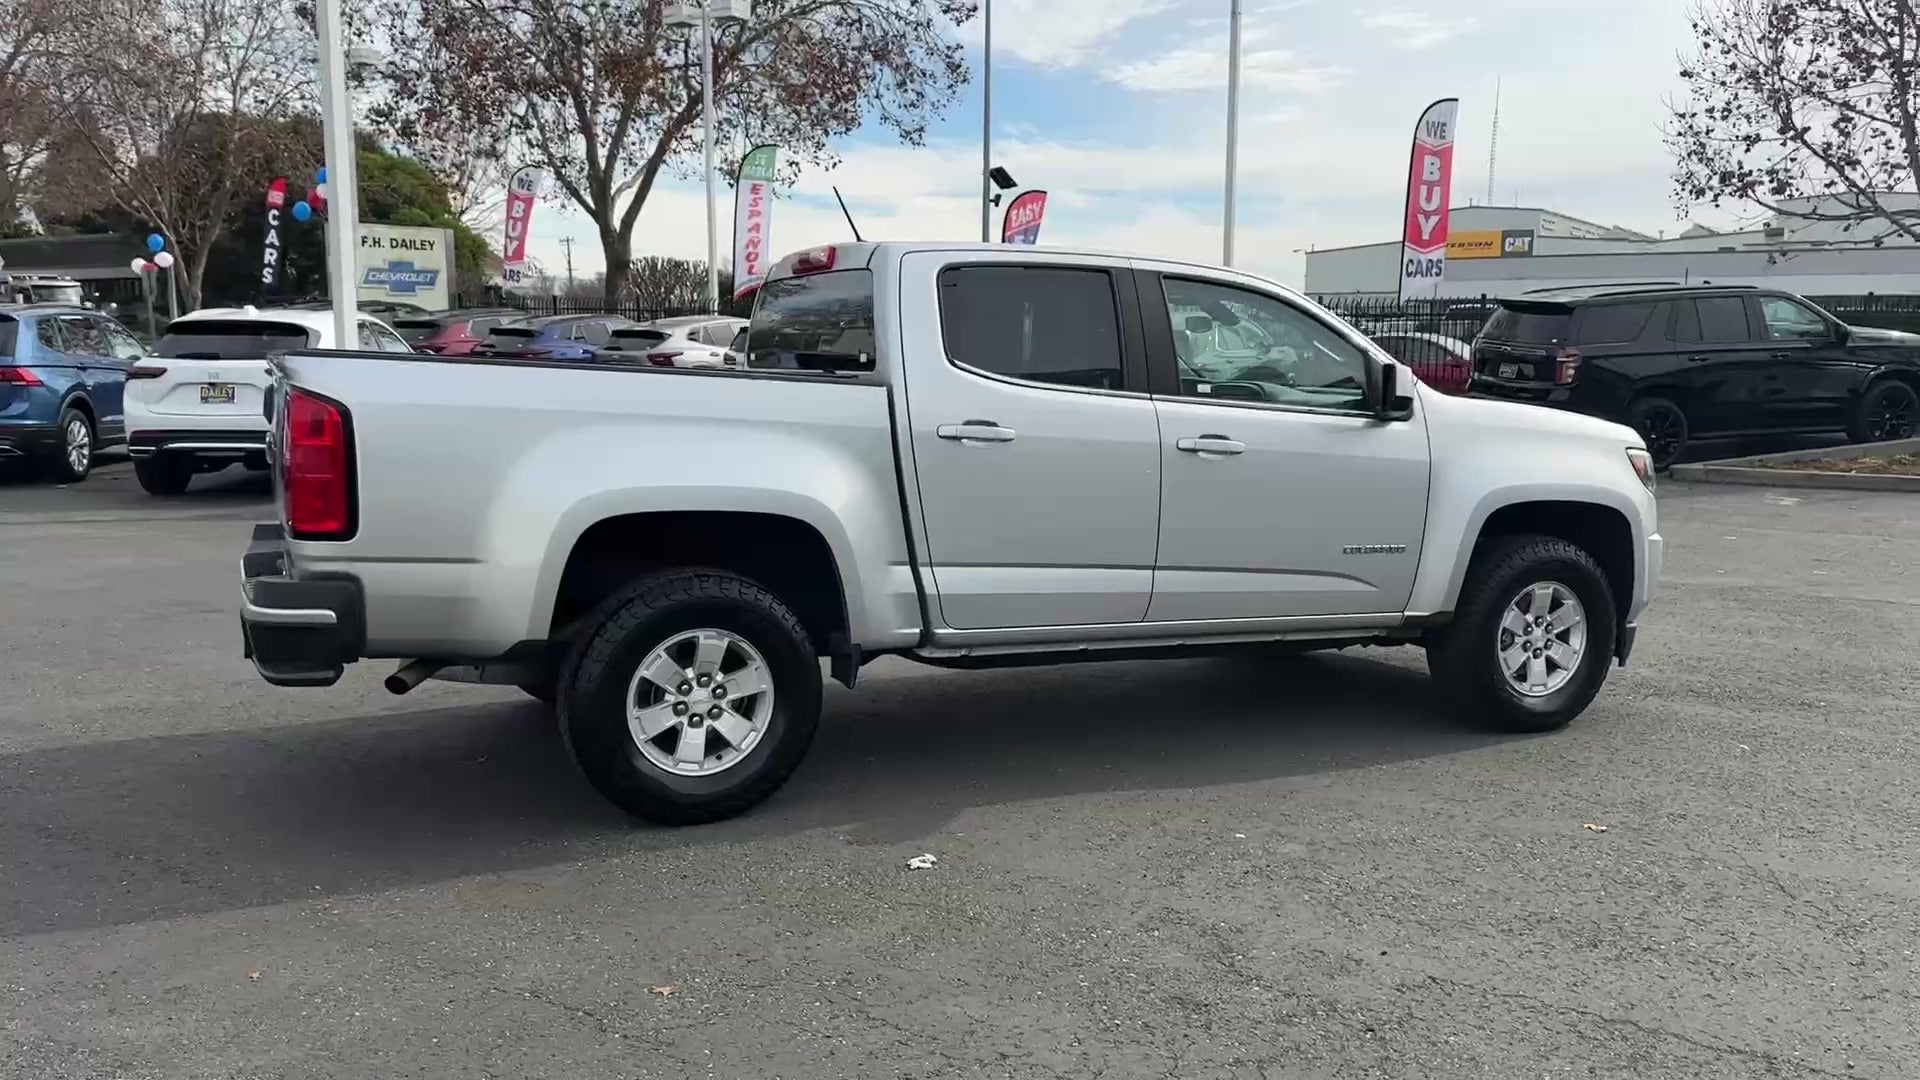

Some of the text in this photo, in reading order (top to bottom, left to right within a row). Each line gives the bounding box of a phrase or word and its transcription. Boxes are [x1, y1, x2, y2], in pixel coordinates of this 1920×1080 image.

[1426, 120, 1447, 140] WE
[517, 176, 533, 192] WE
[1416, 154, 1441, 240] BUY
[1011, 201, 1042, 228] EASY
[507, 200, 526, 257] BUY
[745, 182, 763, 276] ESPAÑOL
[261, 208, 280, 284] CARS
[360, 235, 436, 252] F.H. DAILEY
[1446, 240, 1494, 248] TERSON
[1504, 237, 1532, 252] CAT
[367, 271, 434, 283] CHEVROLET
[503, 268, 521, 283] ARS
[1405, 258, 1443, 279] CARS
[202, 386, 233, 397] DAILEY
